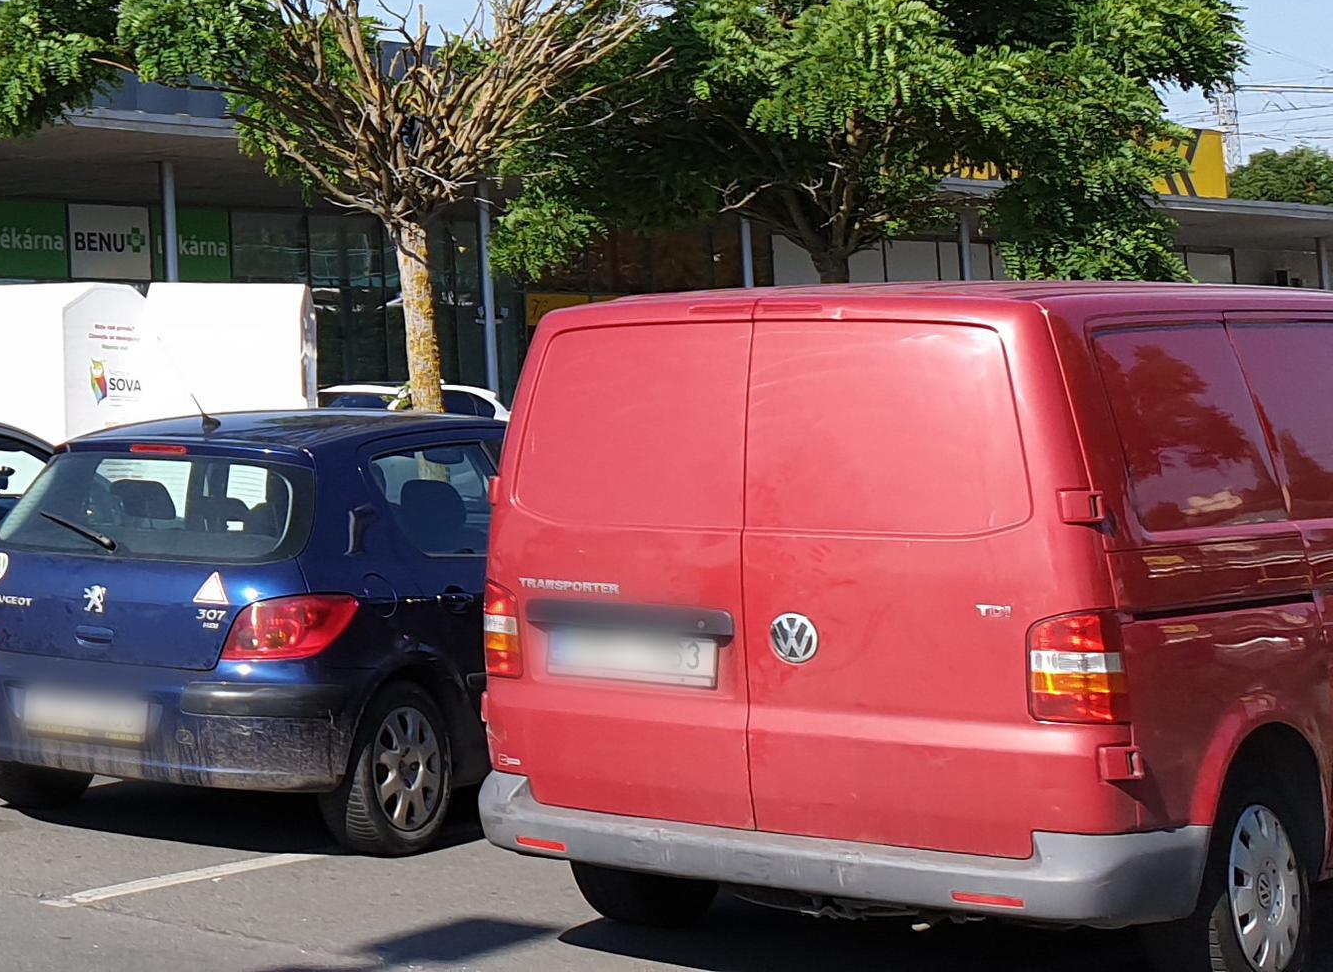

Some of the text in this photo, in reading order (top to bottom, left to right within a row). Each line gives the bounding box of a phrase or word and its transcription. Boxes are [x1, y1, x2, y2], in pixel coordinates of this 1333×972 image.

[74, 231, 126, 253] BENU
[157, 234, 227, 257] Lkárna
[108, 377, 142, 392] SOVA
[518, 577, 621, 595] TRANSPORTER
[195, 607, 227, 621] 307
